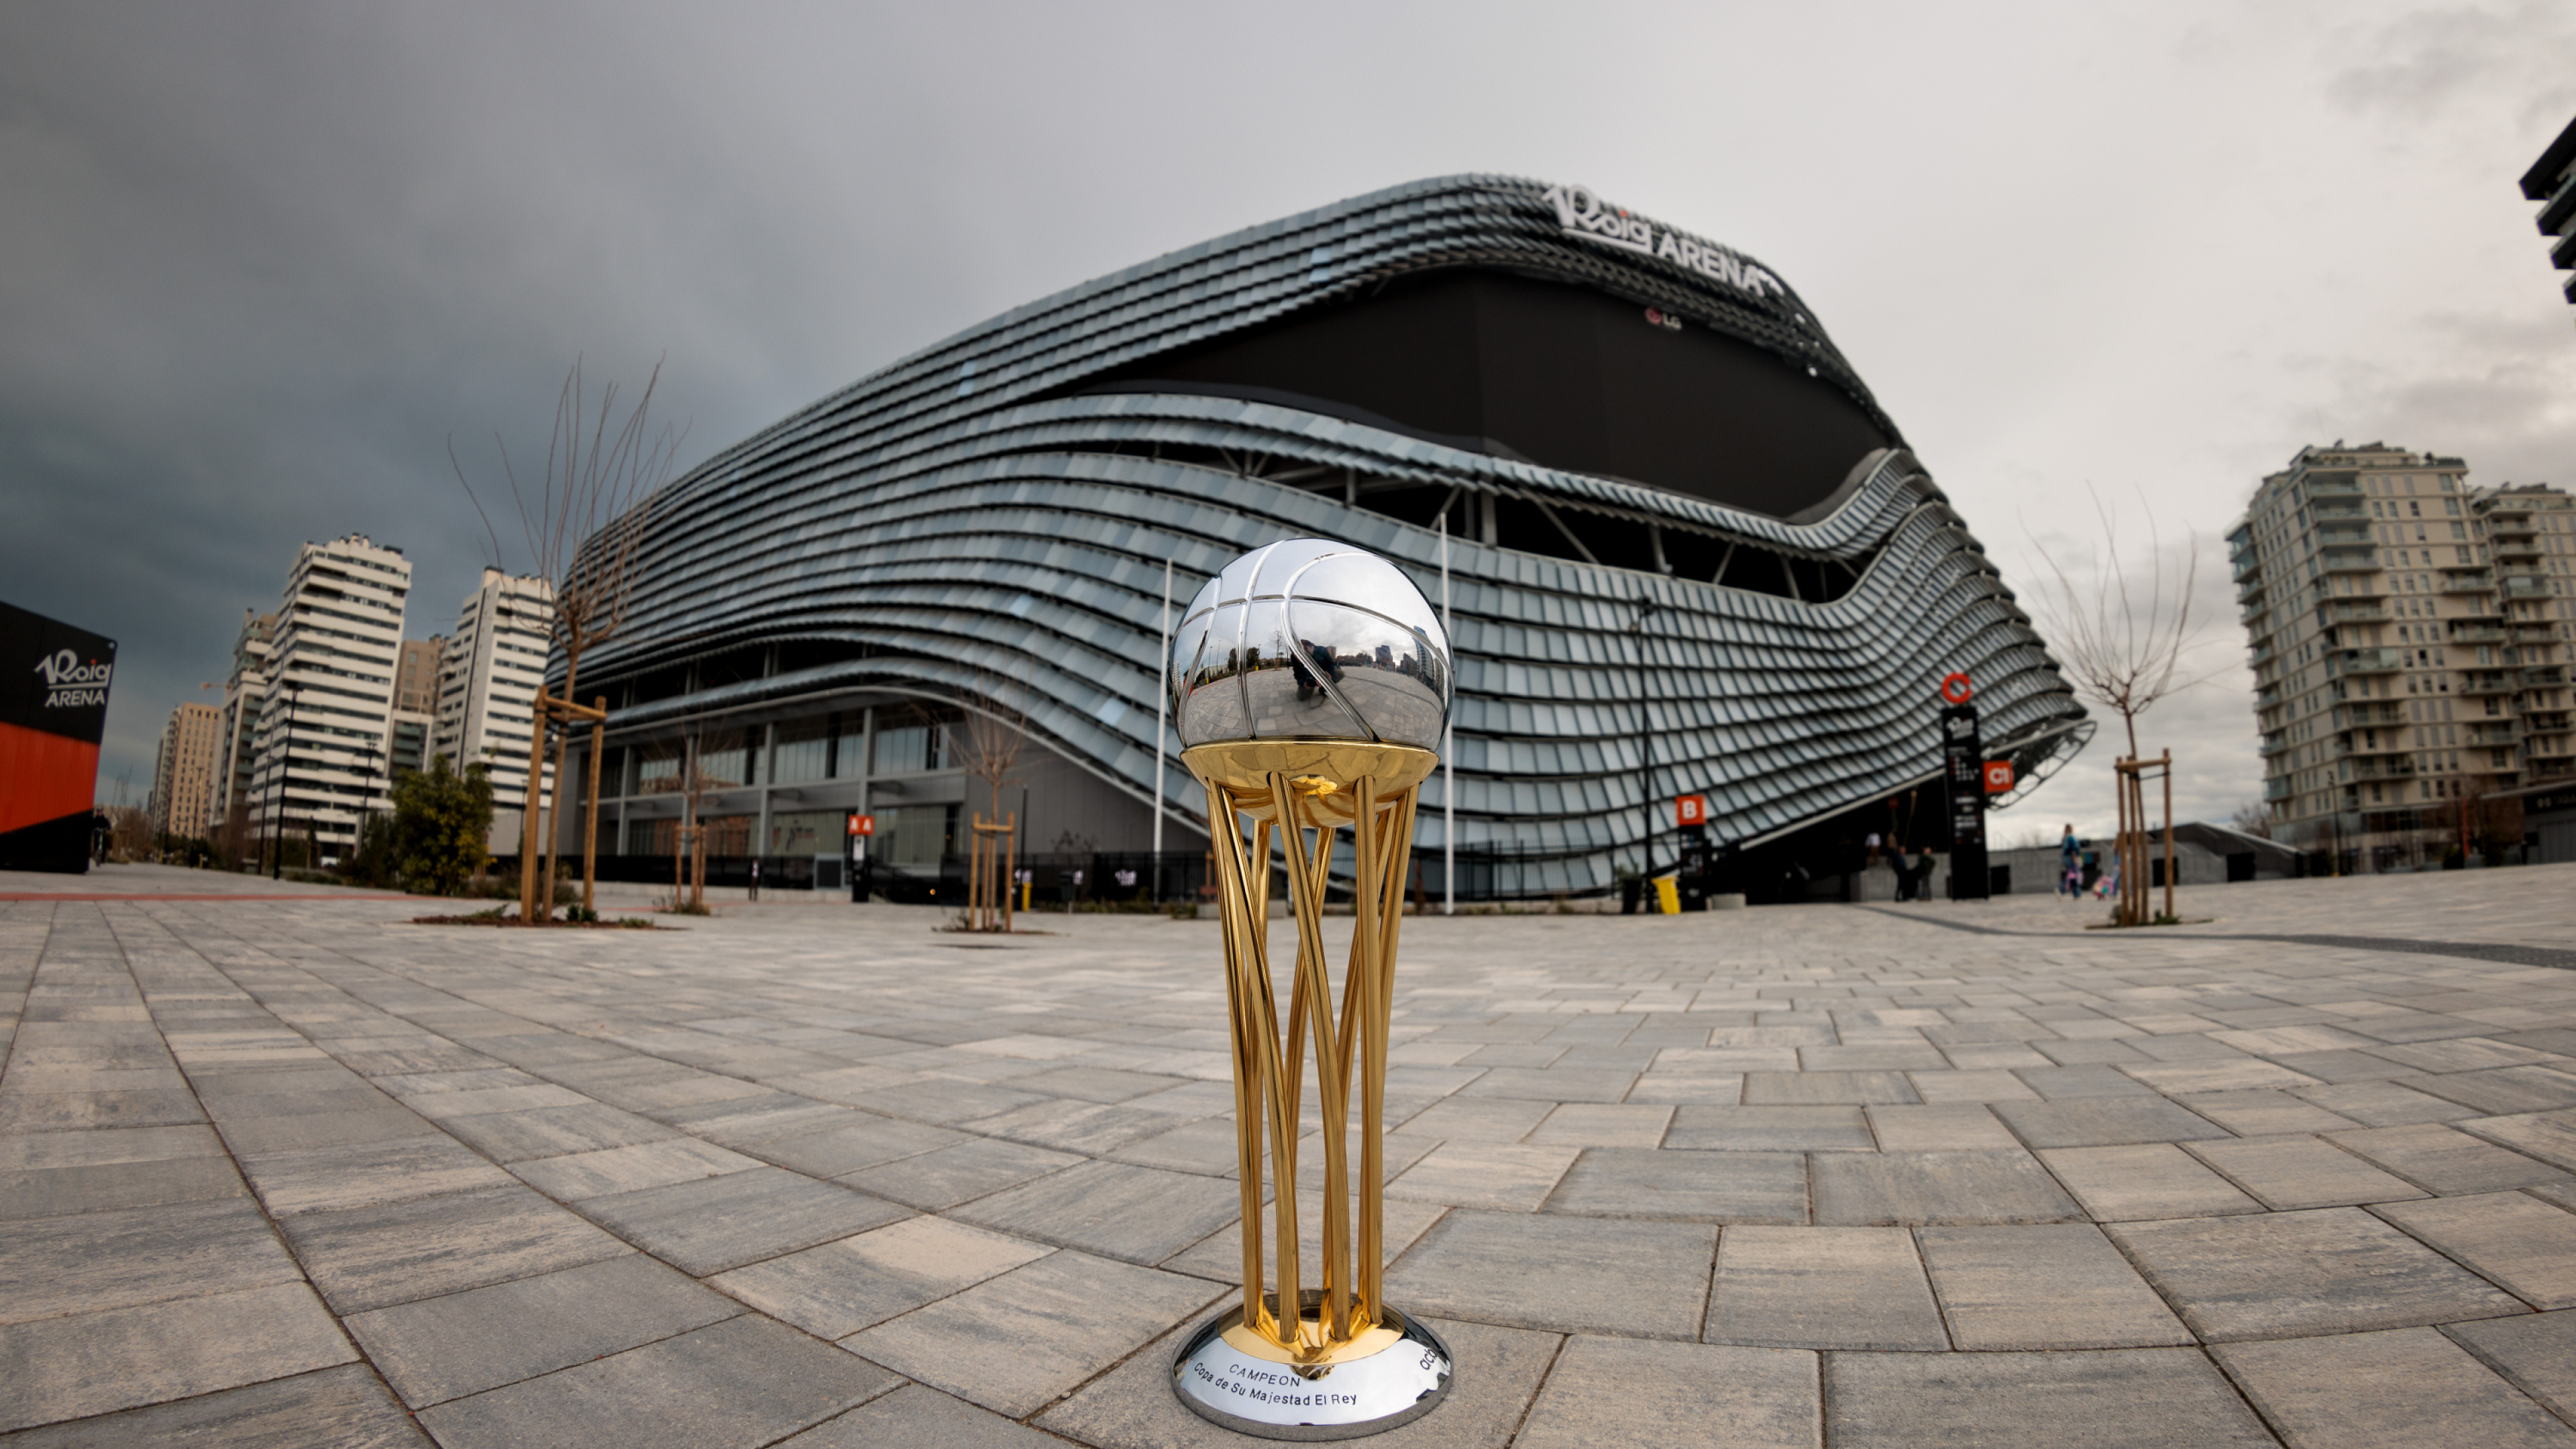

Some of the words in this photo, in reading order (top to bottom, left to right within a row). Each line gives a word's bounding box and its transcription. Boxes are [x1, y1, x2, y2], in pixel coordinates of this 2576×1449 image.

[1542, 184, 1653, 254] Roig
[1656, 231, 1766, 297] ARENA
[34, 648, 112, 690] Roig
[45, 689, 105, 708] ARENA
[1941, 672, 1973, 704] C
[1682, 800, 1697, 820] B
[850, 817, 859, 831] A
[863, 818, 871, 831] A
[1419, 1348, 1438, 1371] acb
[1194, 1362, 1214, 1383] Copa
[1215, 1377, 1229, 1389] de
[1231, 1383, 1246, 1395] Su
[1249, 1388, 1310, 1406] Majestad
[1315, 1394, 1327, 1406] El
[1331, 1394, 1356, 1405] Rey
[1229, 1364, 1301, 1387] CAMPEON
